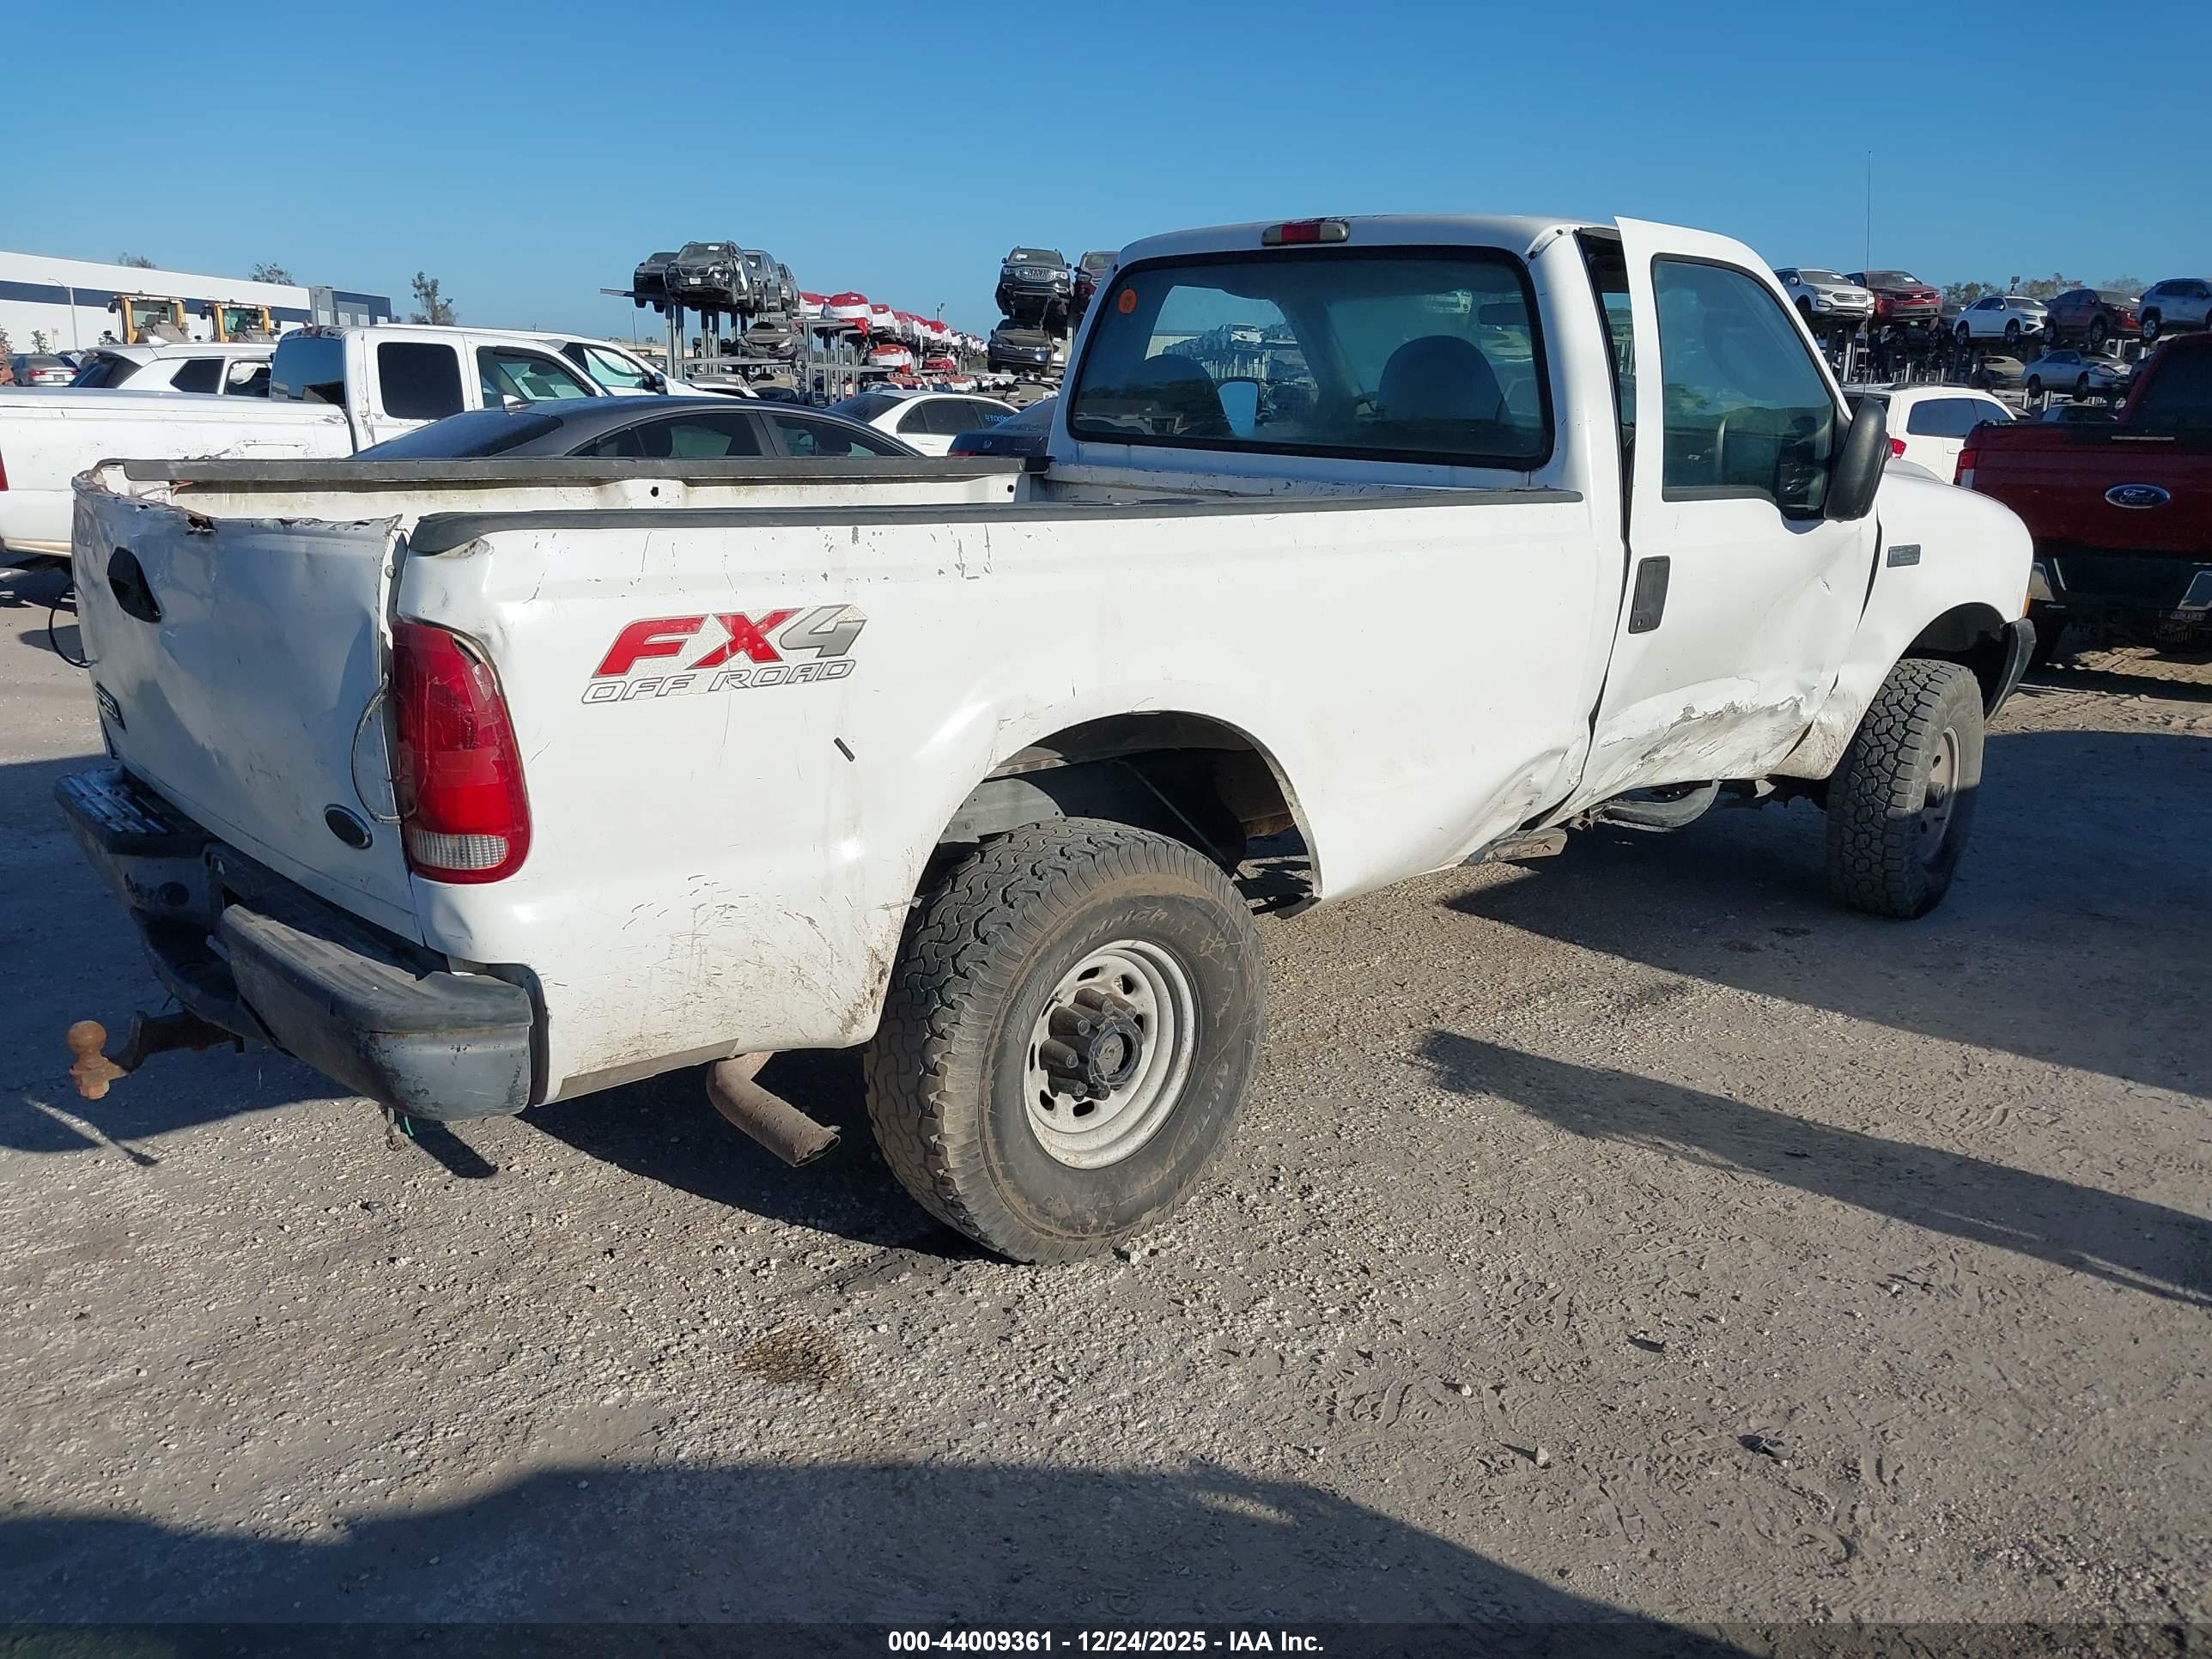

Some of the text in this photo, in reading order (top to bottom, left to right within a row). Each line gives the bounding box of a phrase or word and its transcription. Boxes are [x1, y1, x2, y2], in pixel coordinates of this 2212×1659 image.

[591, 604, 867, 678] FX4
[582, 659, 856, 704] OFF ROAD
